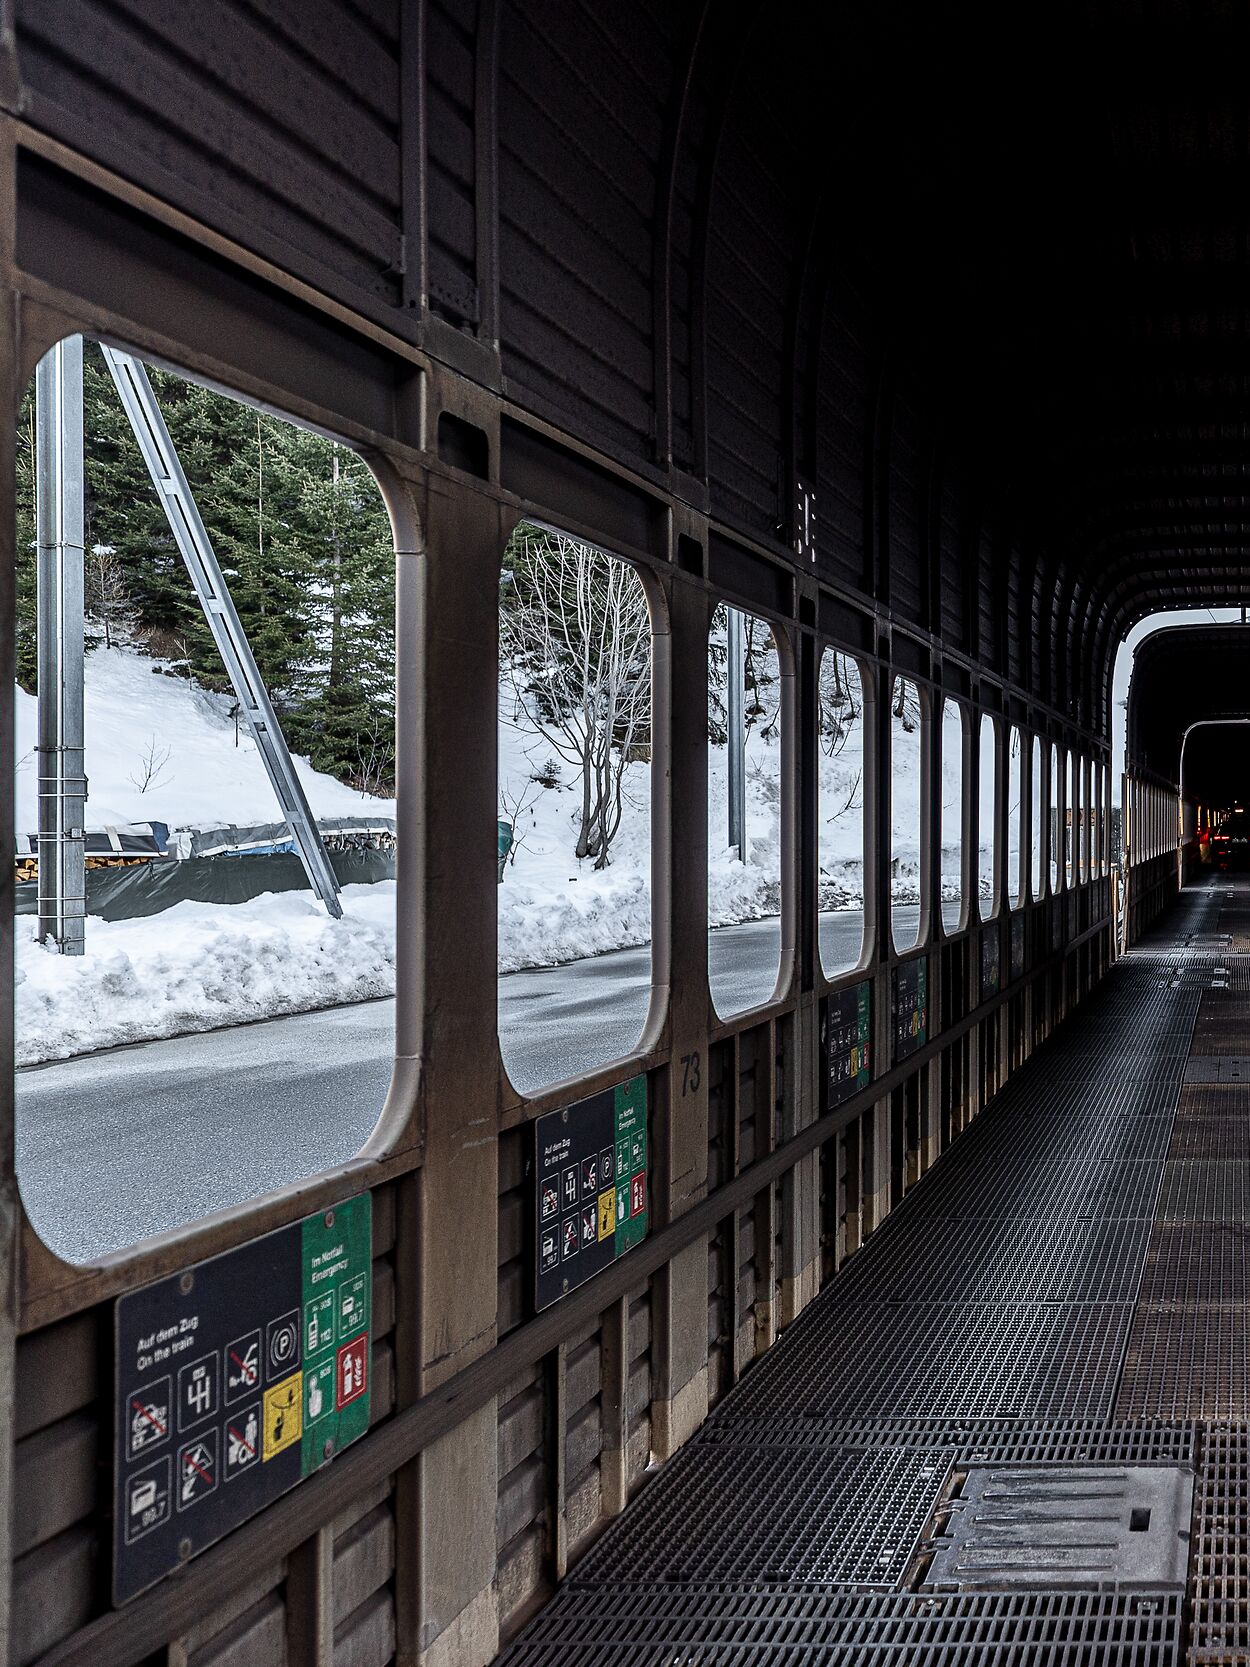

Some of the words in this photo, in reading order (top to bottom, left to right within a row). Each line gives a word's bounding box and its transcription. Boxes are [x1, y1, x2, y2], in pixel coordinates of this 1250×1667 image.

[680, 1051, 700, 1097] 73
[311, 1257, 321, 1268] Im
[322, 1244, 343, 1263] Notfall
[311, 1258, 349, 1284] Emergency
[137, 1333, 155, 1353] Auf
[156, 1325, 178, 1343] dem
[179, 1316, 198, 1333] Zug
[137, 1356, 153, 1370] On
[154, 1347, 171, 1363] the
[172, 1336, 194, 1354] train
